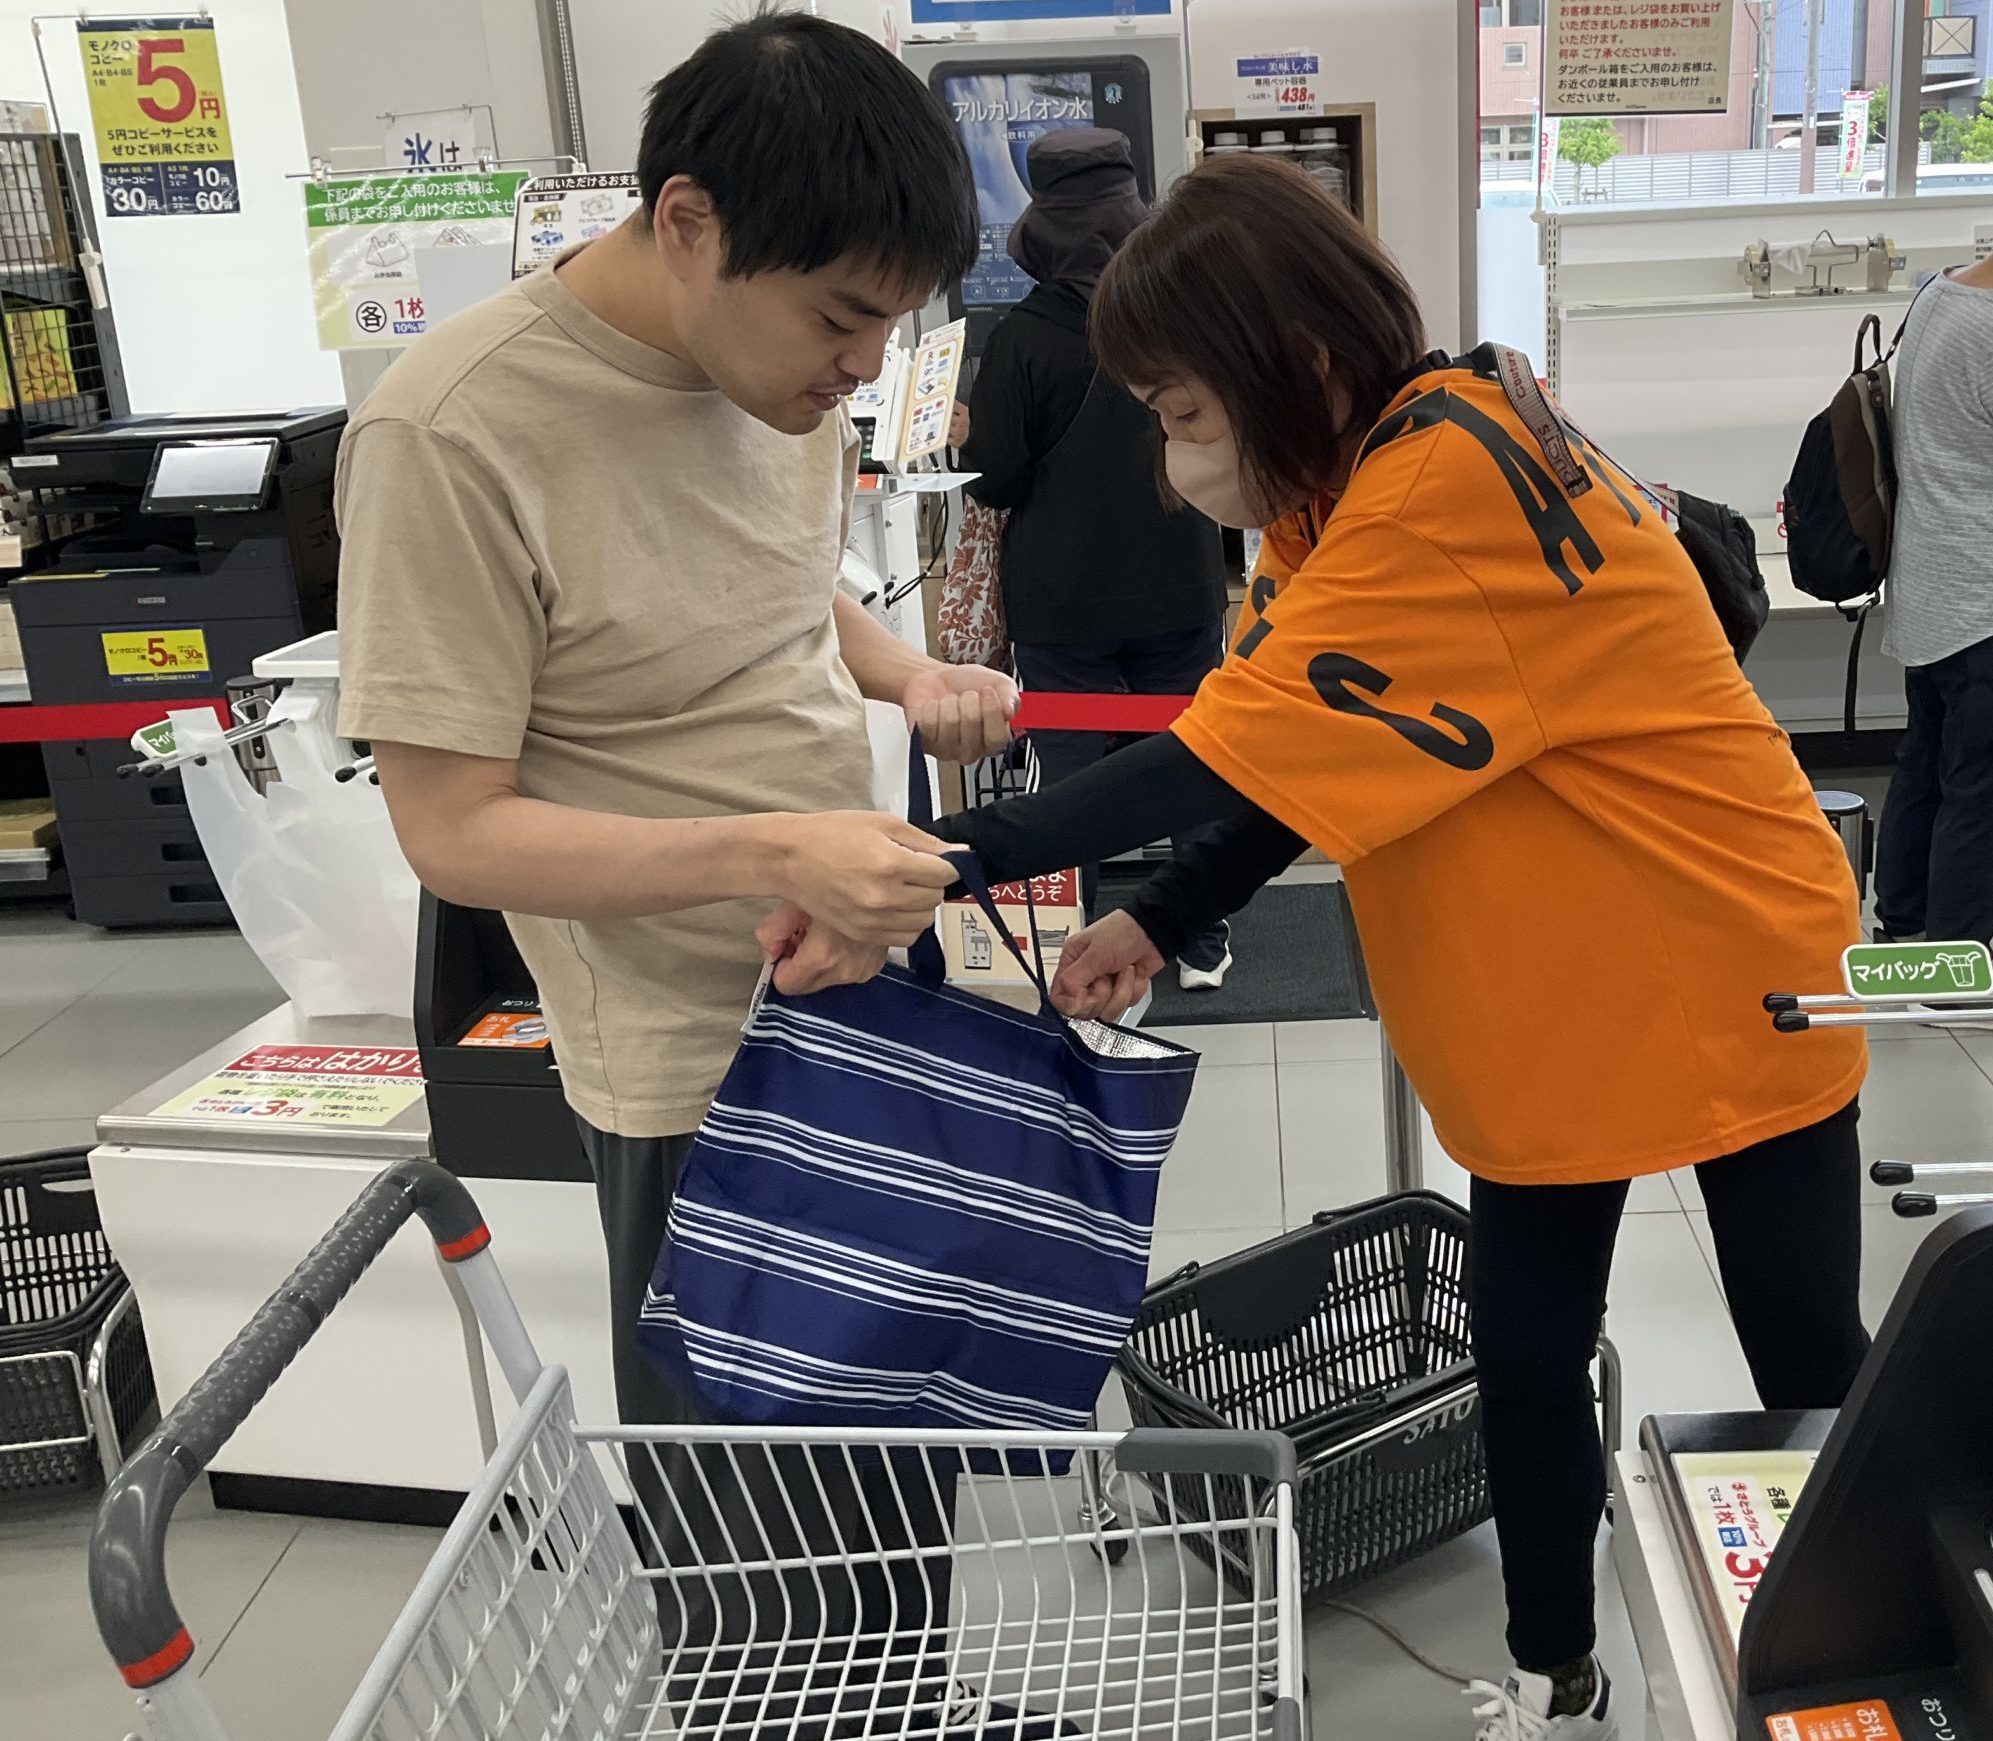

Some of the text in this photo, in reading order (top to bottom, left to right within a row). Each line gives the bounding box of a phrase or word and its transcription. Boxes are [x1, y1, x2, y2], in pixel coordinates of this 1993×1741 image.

[1560, 17, 1711, 31] いただきましたお客様のみご利用
[88, 40, 132, 51] モノクロ
[1559, 34, 1624, 45] いただけます。
[90, 54, 123, 65] コピー
[1558, 77, 1700, 90] お近くの従業員までお申し付け
[1558, 92, 1622, 103] くださいませ。
[953, 96, 1089, 123] アルカリイオン水
[107, 127, 218, 141] 5円コピーサービスを
[112, 143, 219, 155] ぜひご利用ください
[361, 306, 382, 327] 各
[1853, 960, 1941, 982] マイバッグ
